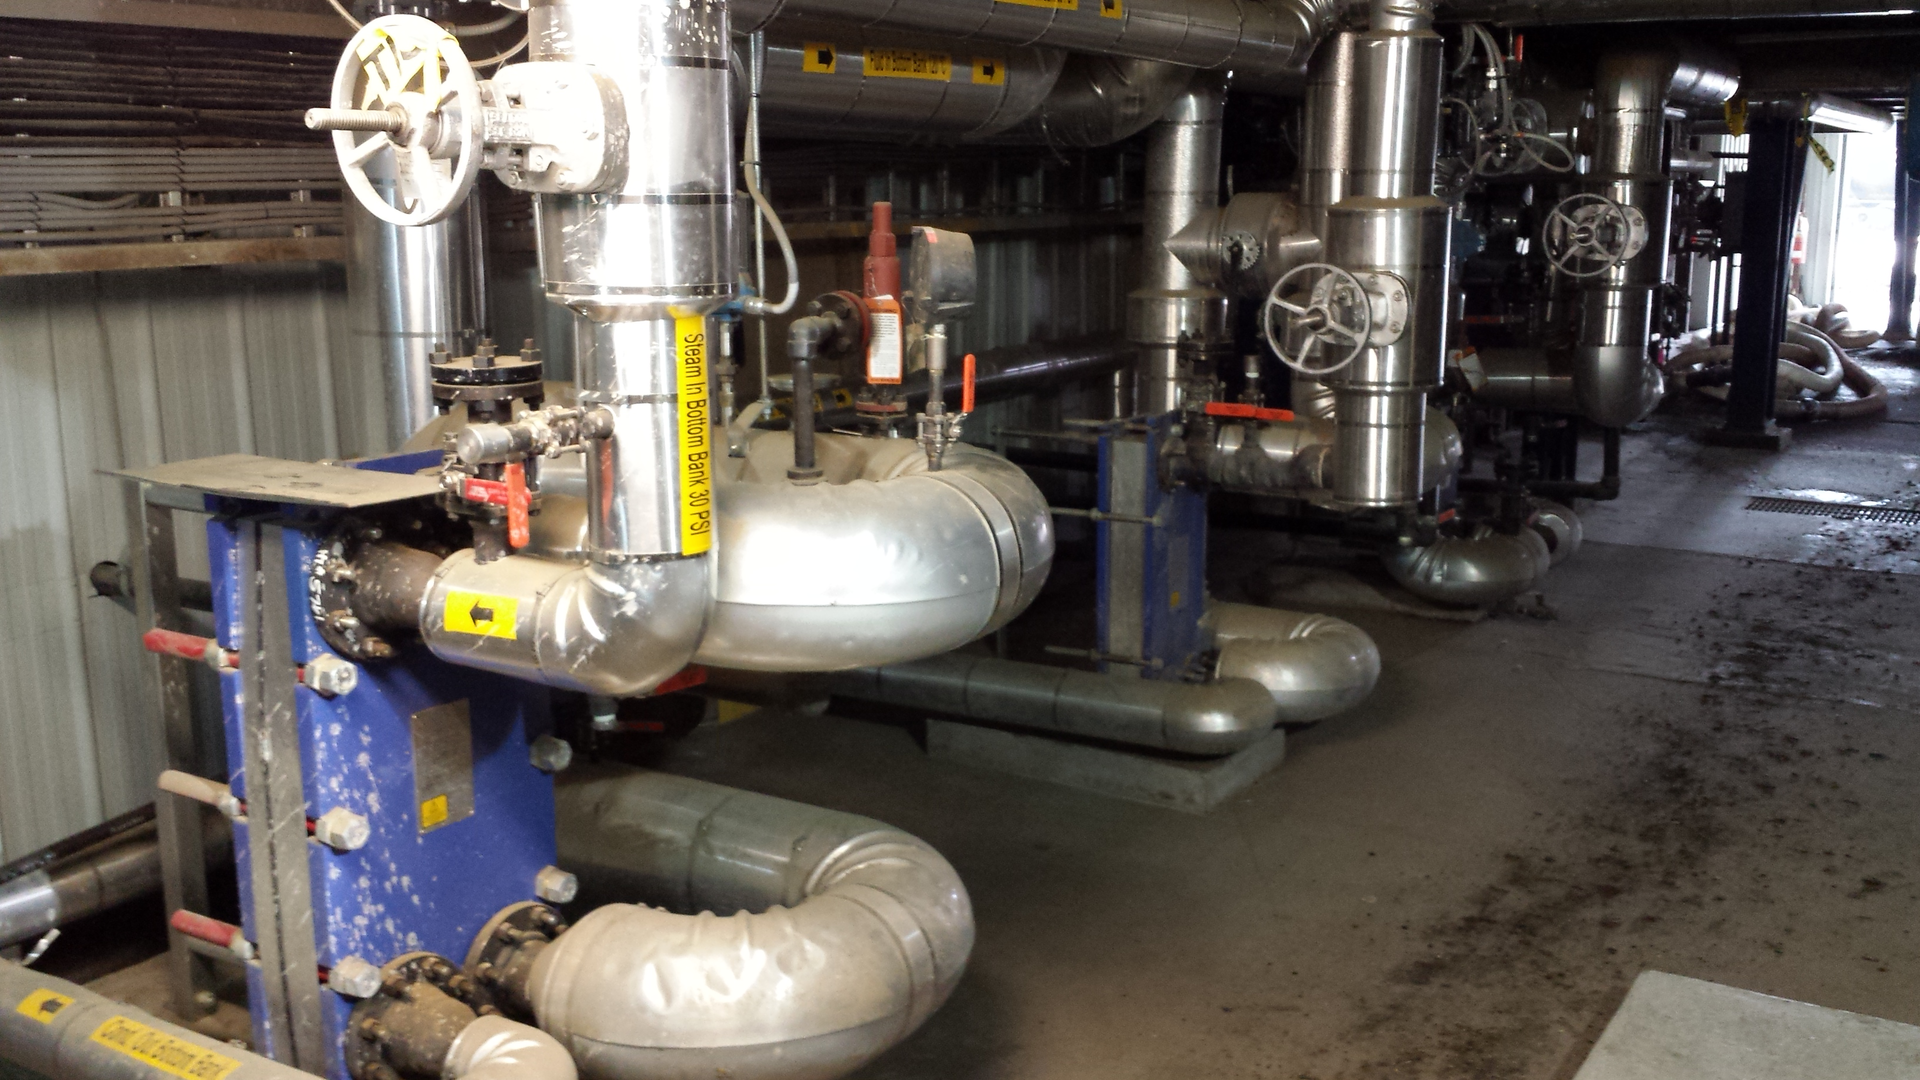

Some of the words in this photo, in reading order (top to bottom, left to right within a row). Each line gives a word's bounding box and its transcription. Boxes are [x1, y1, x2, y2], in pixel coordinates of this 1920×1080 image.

[892, 51, 912, 73] Bottom
[913, 52, 927, 74] Bank
[684, 334, 704, 378] Steam
[686, 382, 706, 395] In
[687, 399, 707, 448] Bottom
[688, 451, 709, 487] Bank
[689, 490, 710, 507] 30
[690, 510, 711, 536] PSI
